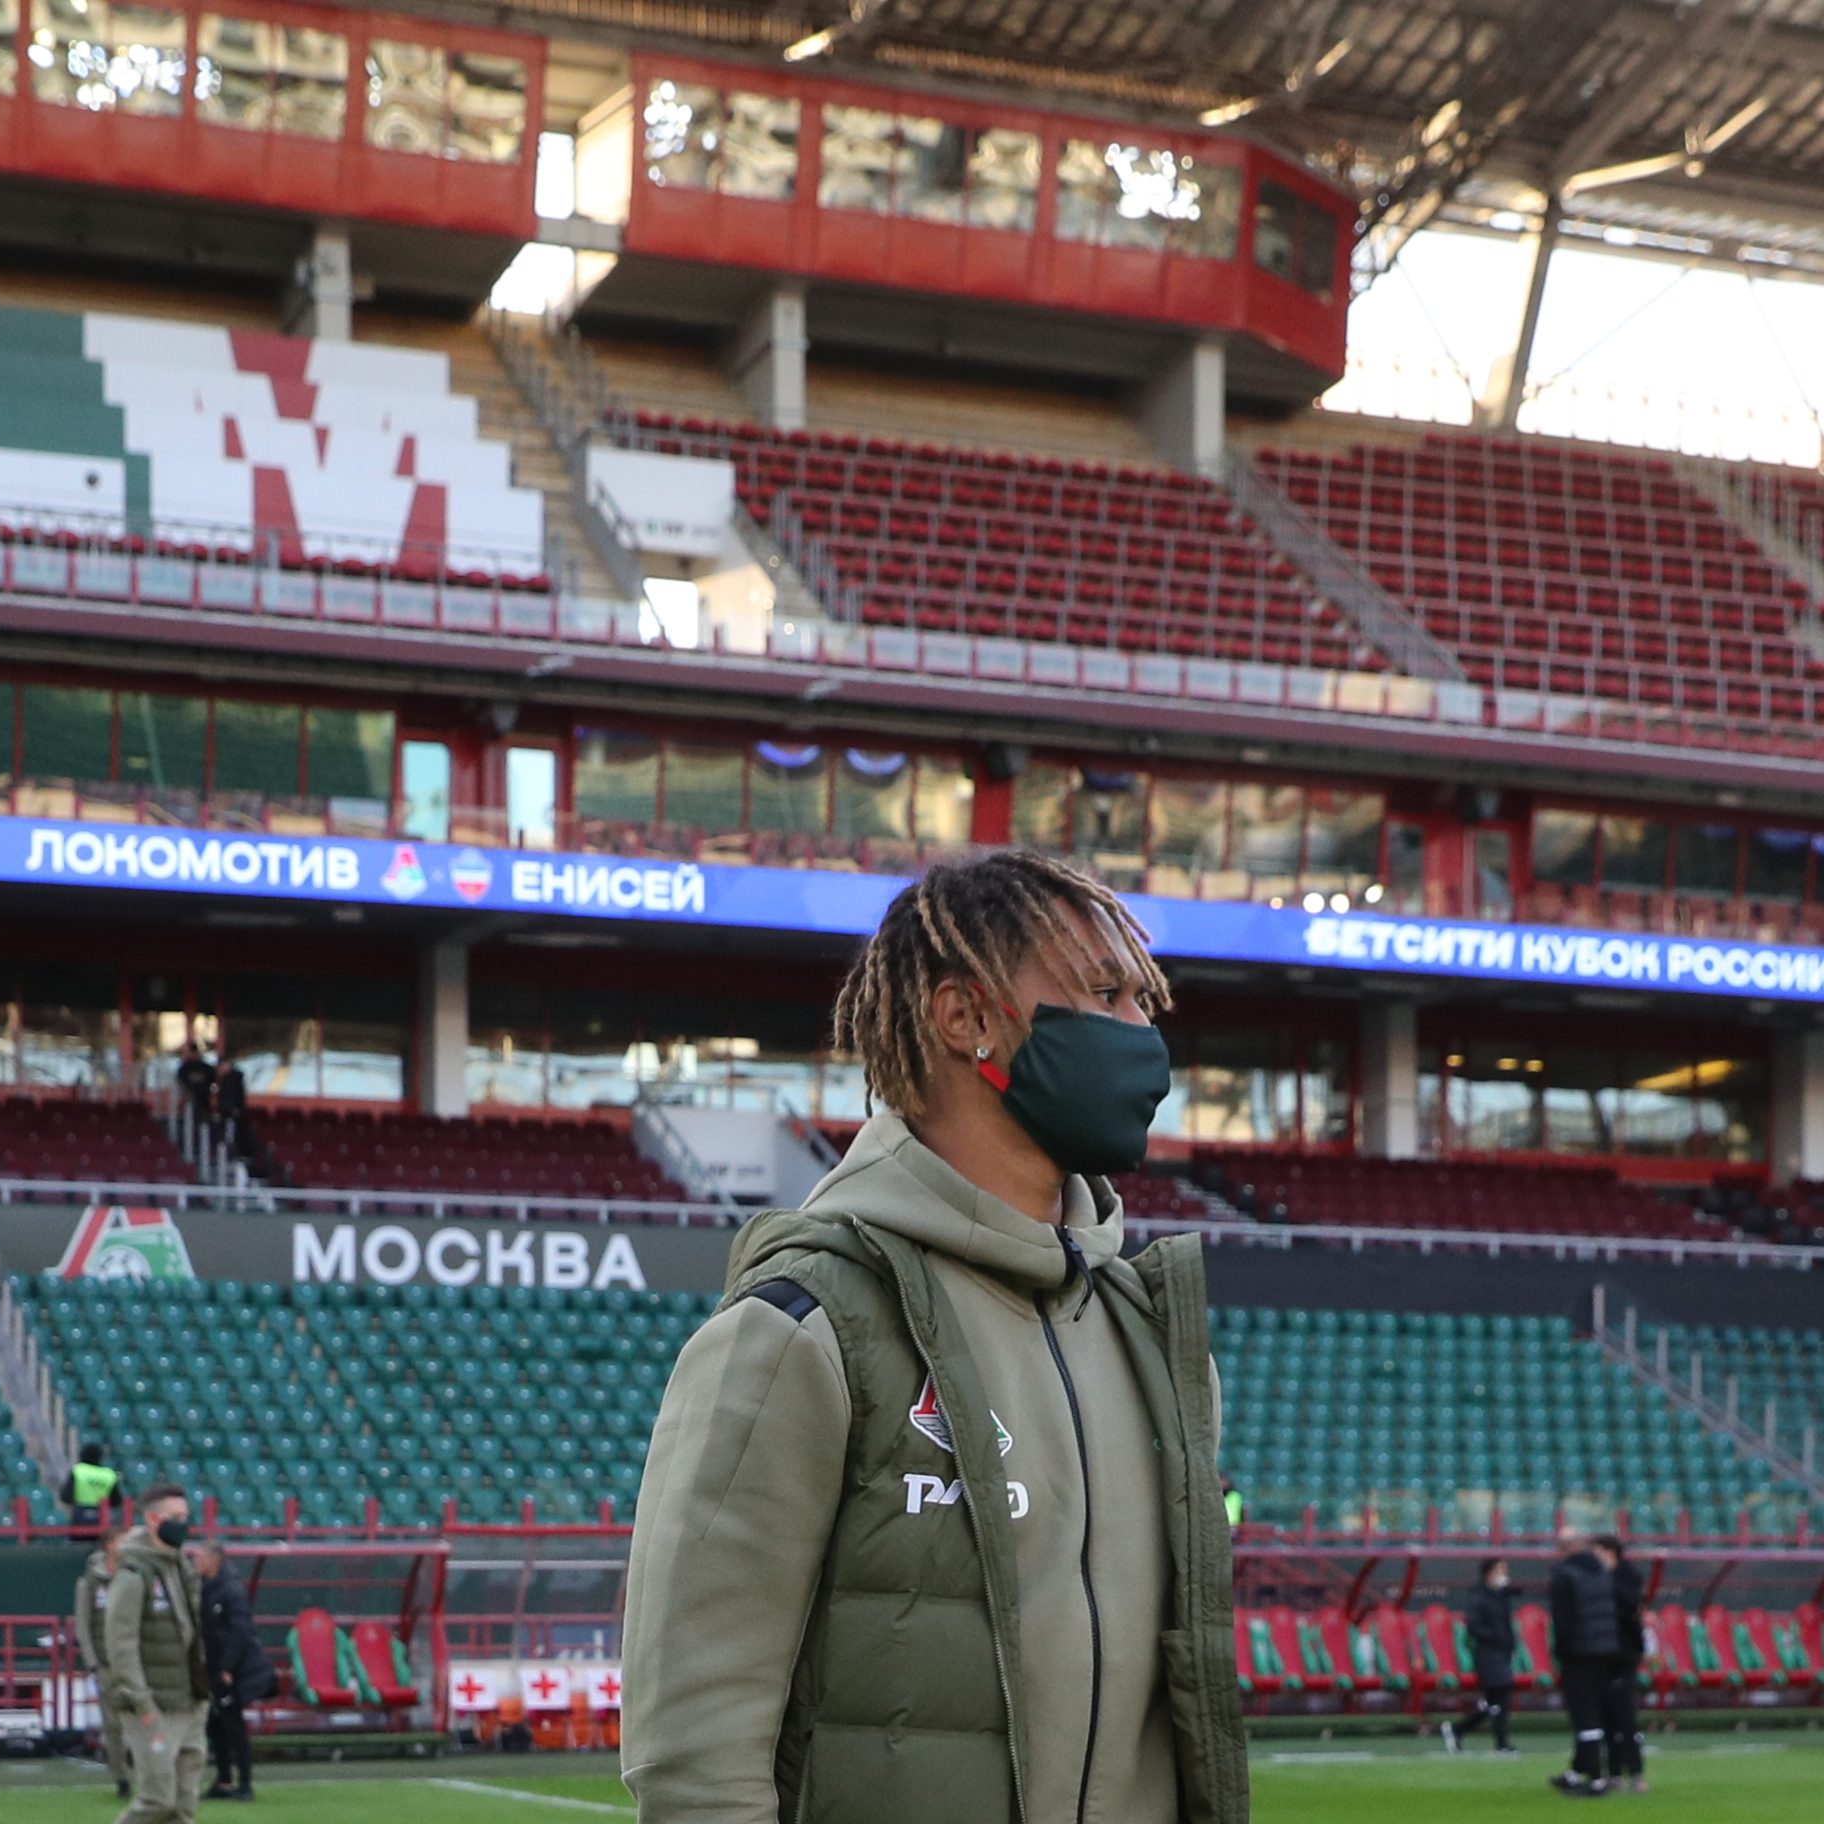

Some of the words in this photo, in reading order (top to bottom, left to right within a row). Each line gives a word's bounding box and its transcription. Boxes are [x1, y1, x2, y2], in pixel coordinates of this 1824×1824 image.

[24, 826, 361, 890] ЛОКОМОТИВ
[511, 860, 706, 913] ЕНИСЕЙ
[1304, 916, 1515, 969] БЕТСИТИ
[1522, 932, 1660, 982] КУБОК
[292, 1222, 647, 1290] МОСКВА
